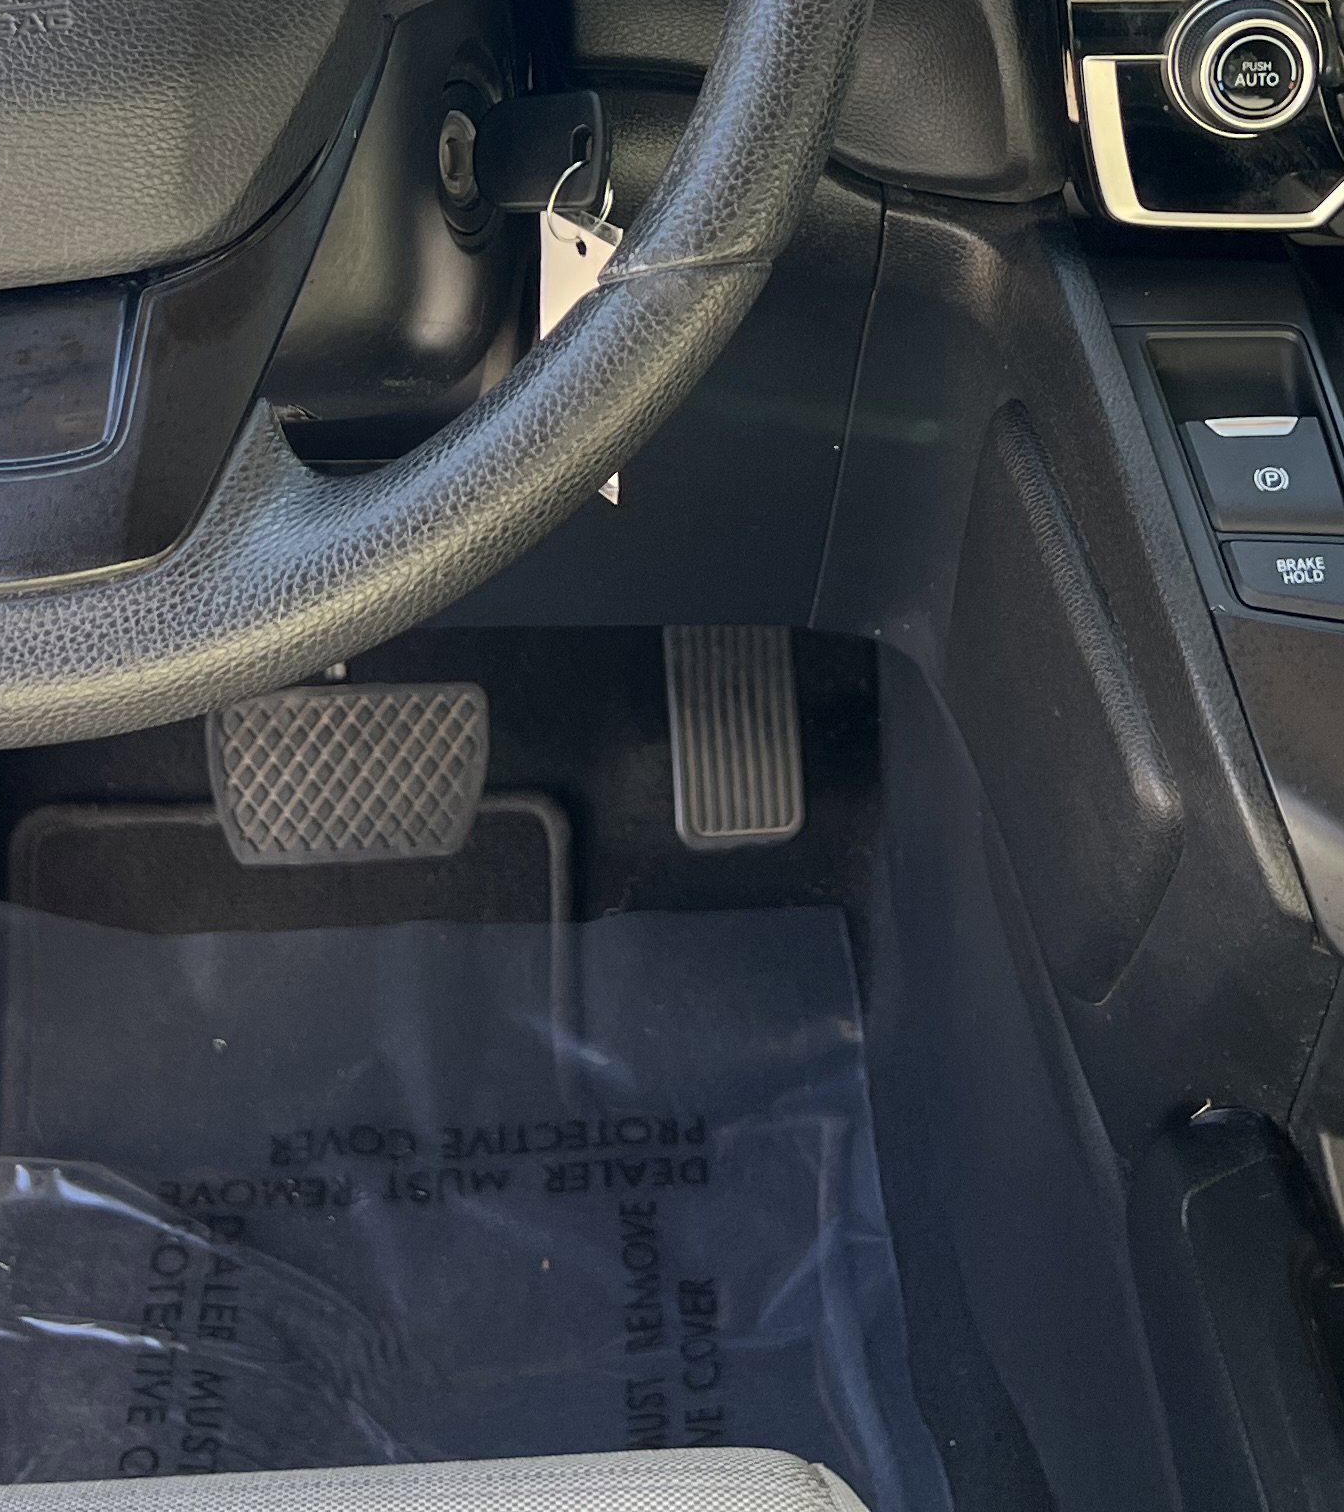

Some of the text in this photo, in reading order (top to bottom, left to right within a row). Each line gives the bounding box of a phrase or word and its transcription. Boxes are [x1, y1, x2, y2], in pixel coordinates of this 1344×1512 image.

[1242, 61, 1272, 72] PUSH
[1234, 72, 1280, 88] AUTO
[1276, 556, 1325, 573] BRAKE
[1282, 570, 1325, 584] HOLD
[543, 1157, 708, 1193] DEALER
[383, 1166, 510, 1204] MUST
